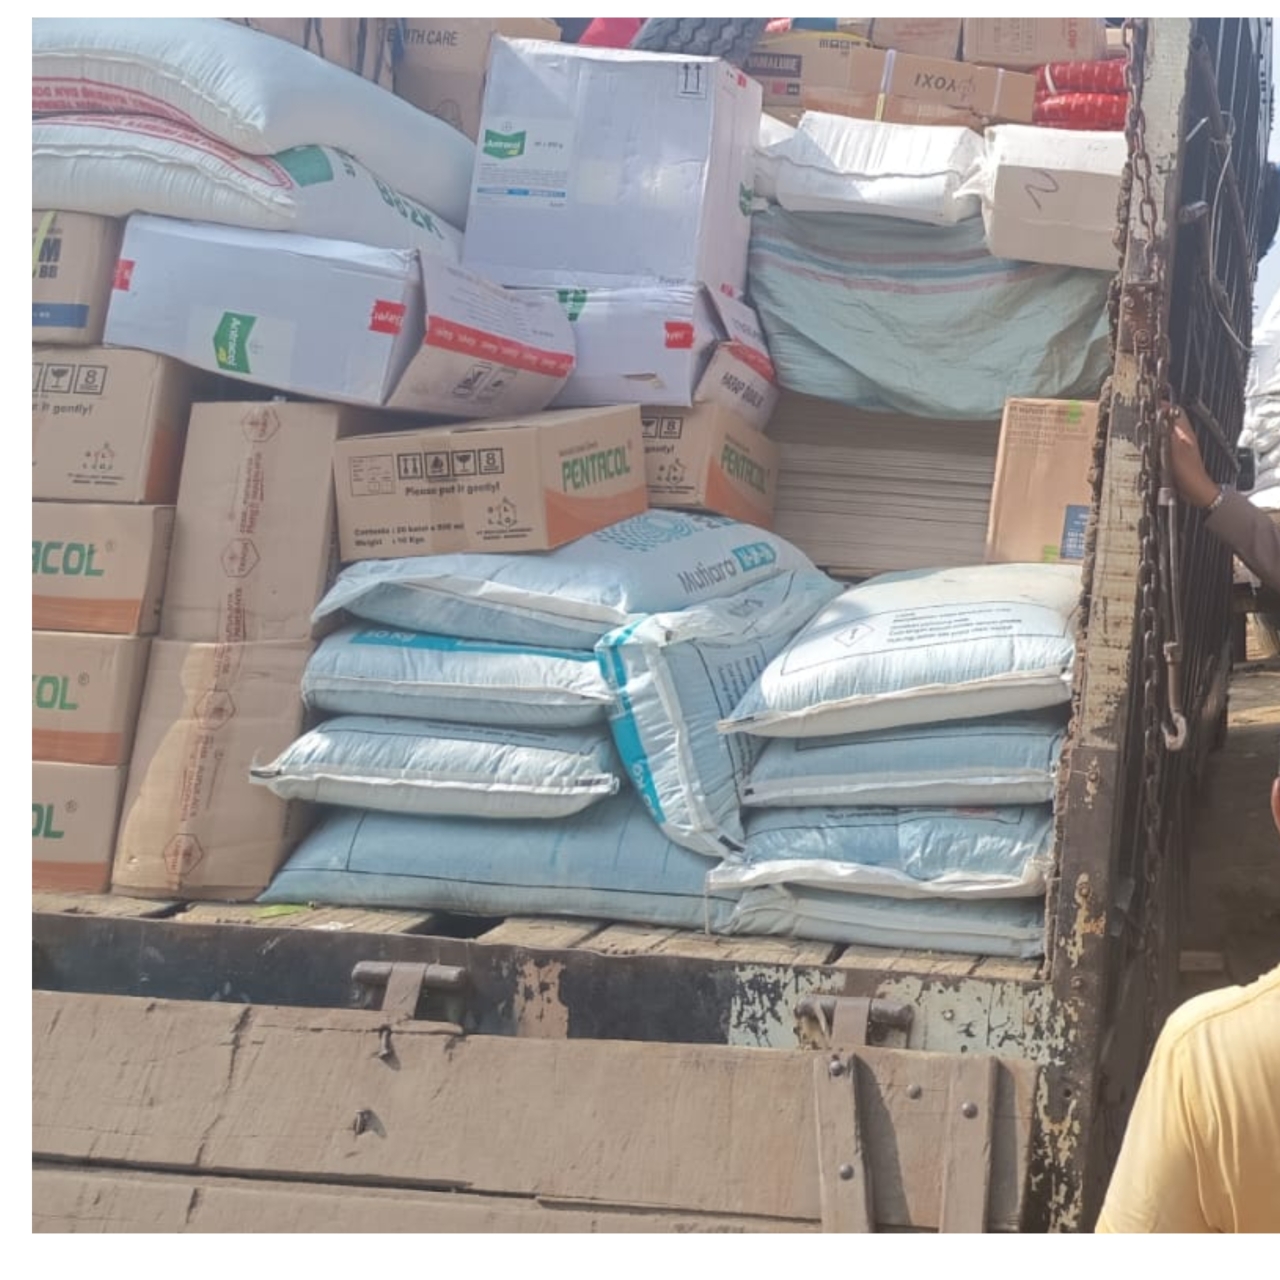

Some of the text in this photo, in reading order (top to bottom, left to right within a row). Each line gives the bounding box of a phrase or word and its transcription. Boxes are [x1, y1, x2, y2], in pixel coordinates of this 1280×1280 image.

[426, 28, 460, 47] CARE
[913, 72, 956, 91] YOXI
[227, 317, 242, 367] Antracol
[485, 452, 496, 466] 8
[561, 444, 631, 493] PENTACOL
[720, 442, 767, 495] PENTACOL
[405, 485, 437, 497] Please
[467, 481, 500, 495] gently!
[677, 557, 738, 596] Mutiara
[32, 674, 78, 711] OL
